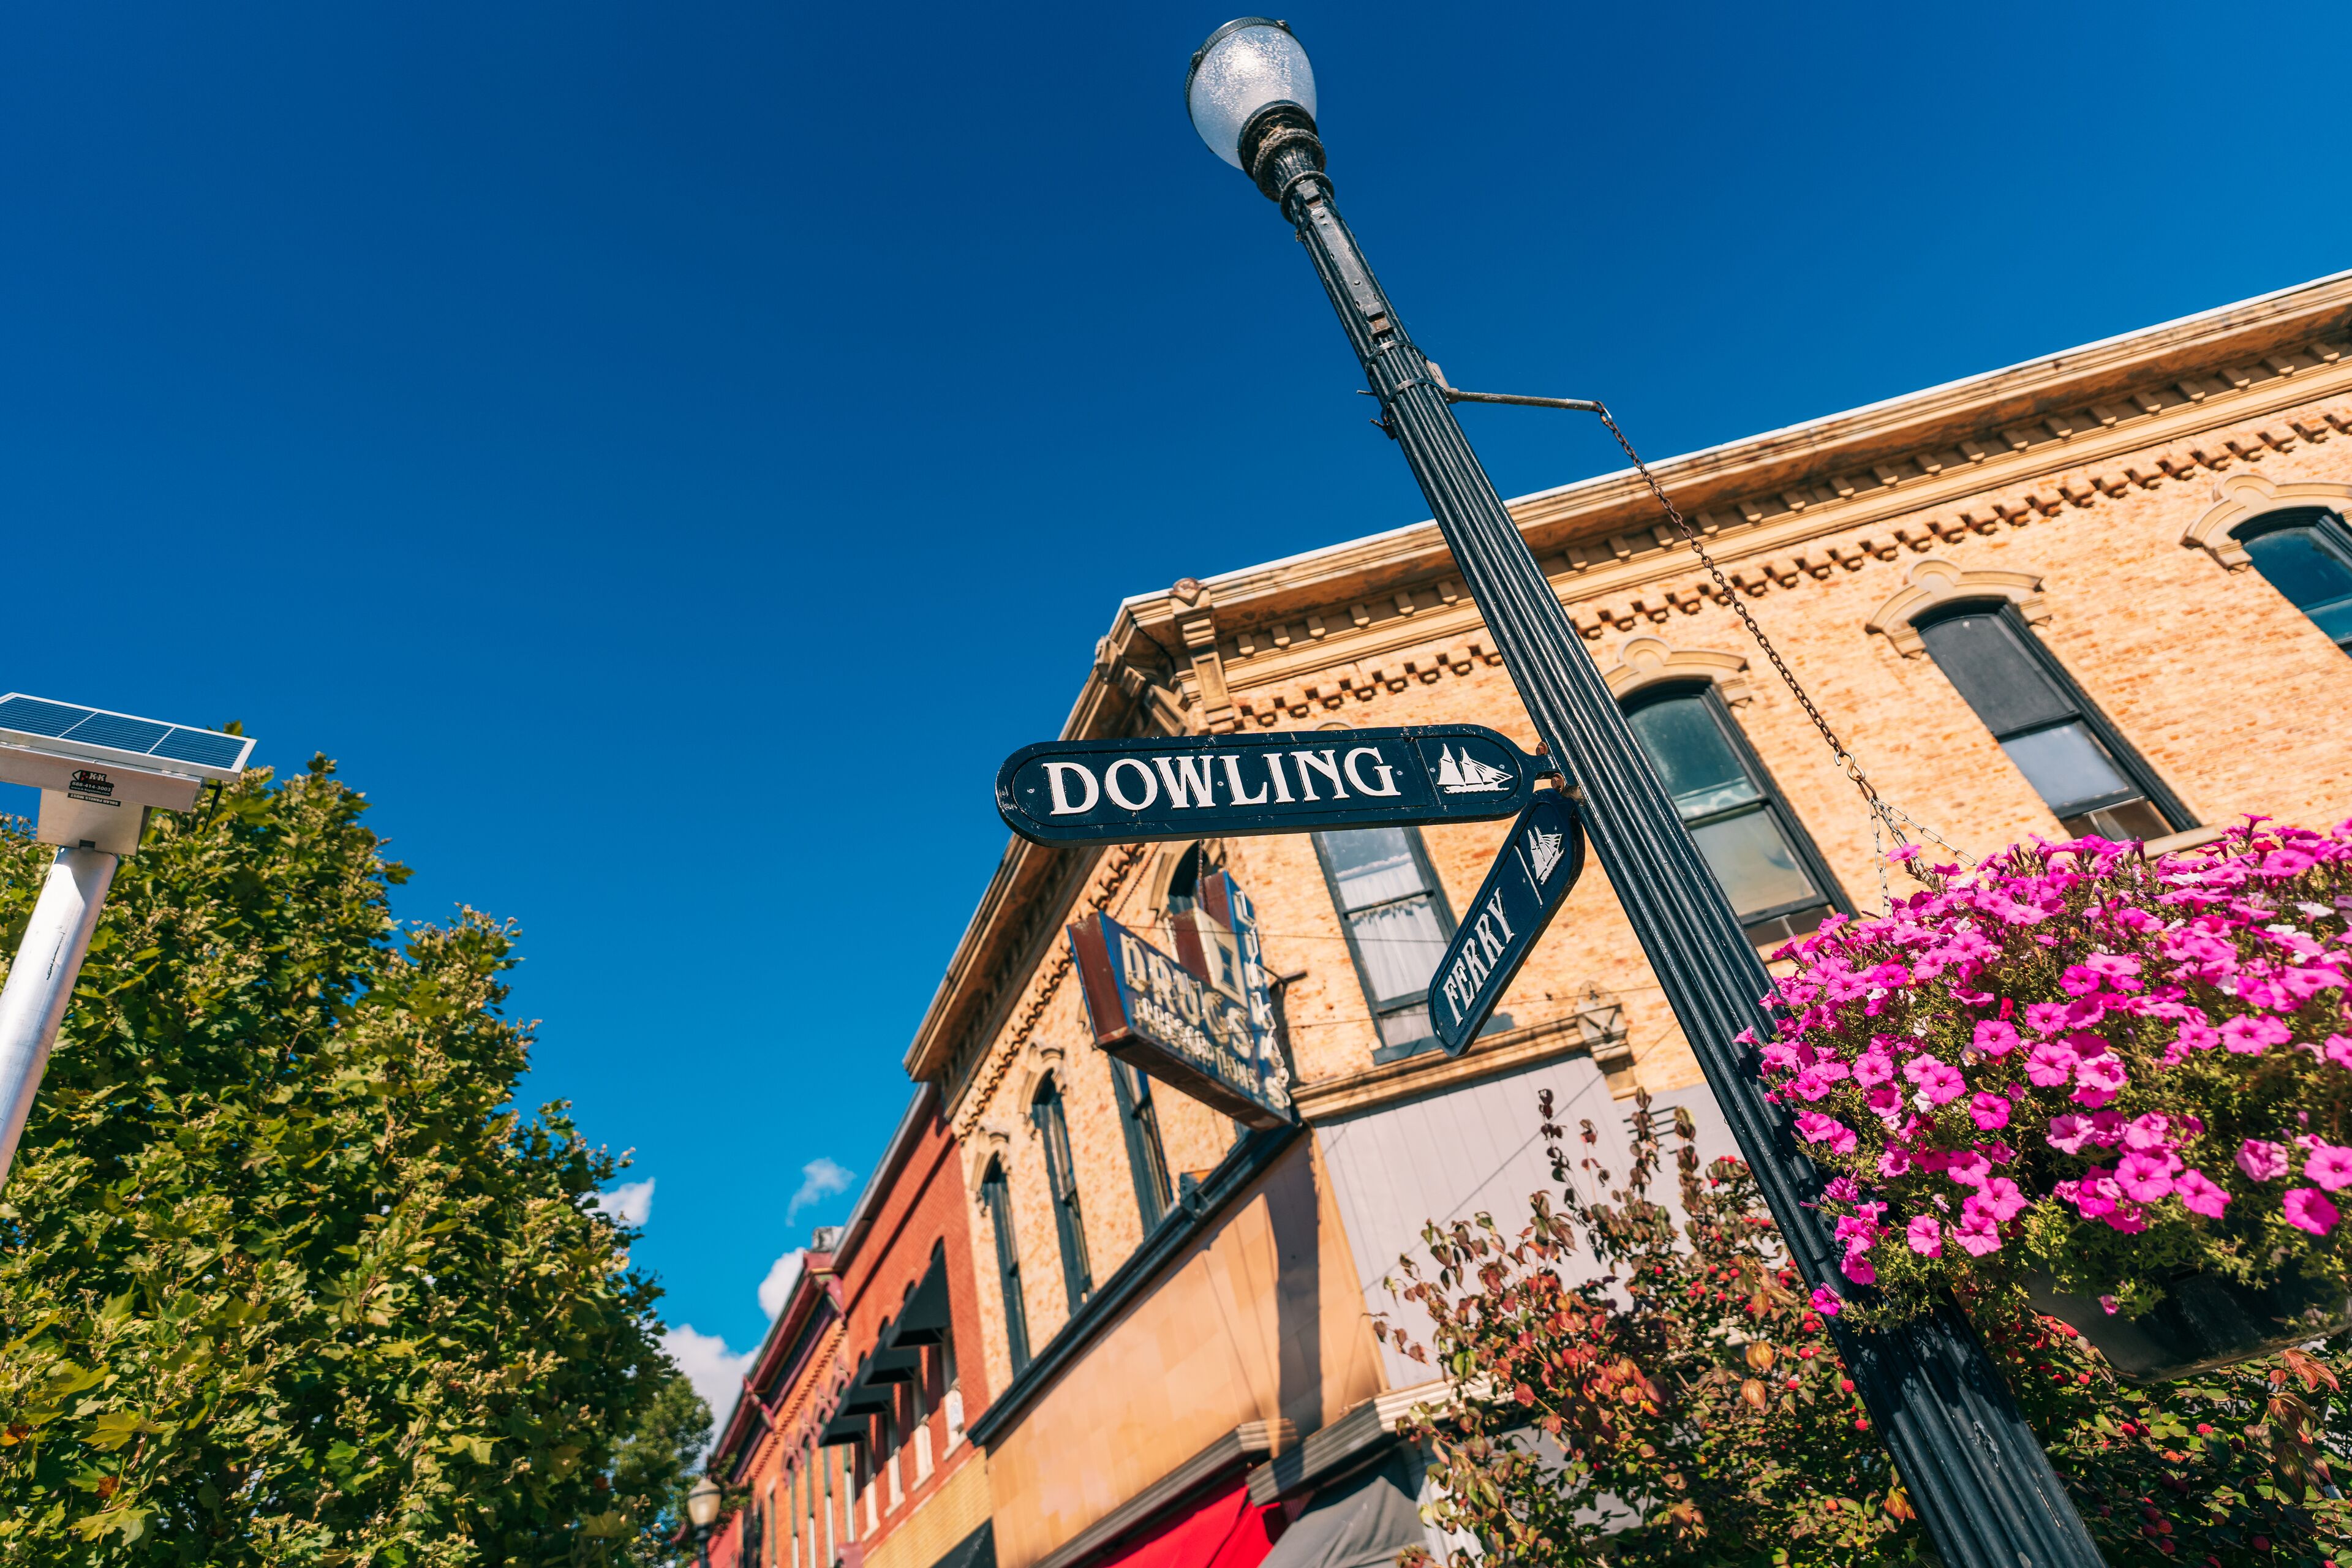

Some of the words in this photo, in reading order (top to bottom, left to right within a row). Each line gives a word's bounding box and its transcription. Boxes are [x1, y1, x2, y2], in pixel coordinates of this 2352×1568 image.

[72, 781, 111, 792] 888-414-3003
[1042, 747, 1401, 816] DOWLING
[1120, 932, 1254, 1060] DRUGS
[1442, 887, 1515, 1027] FERRY
